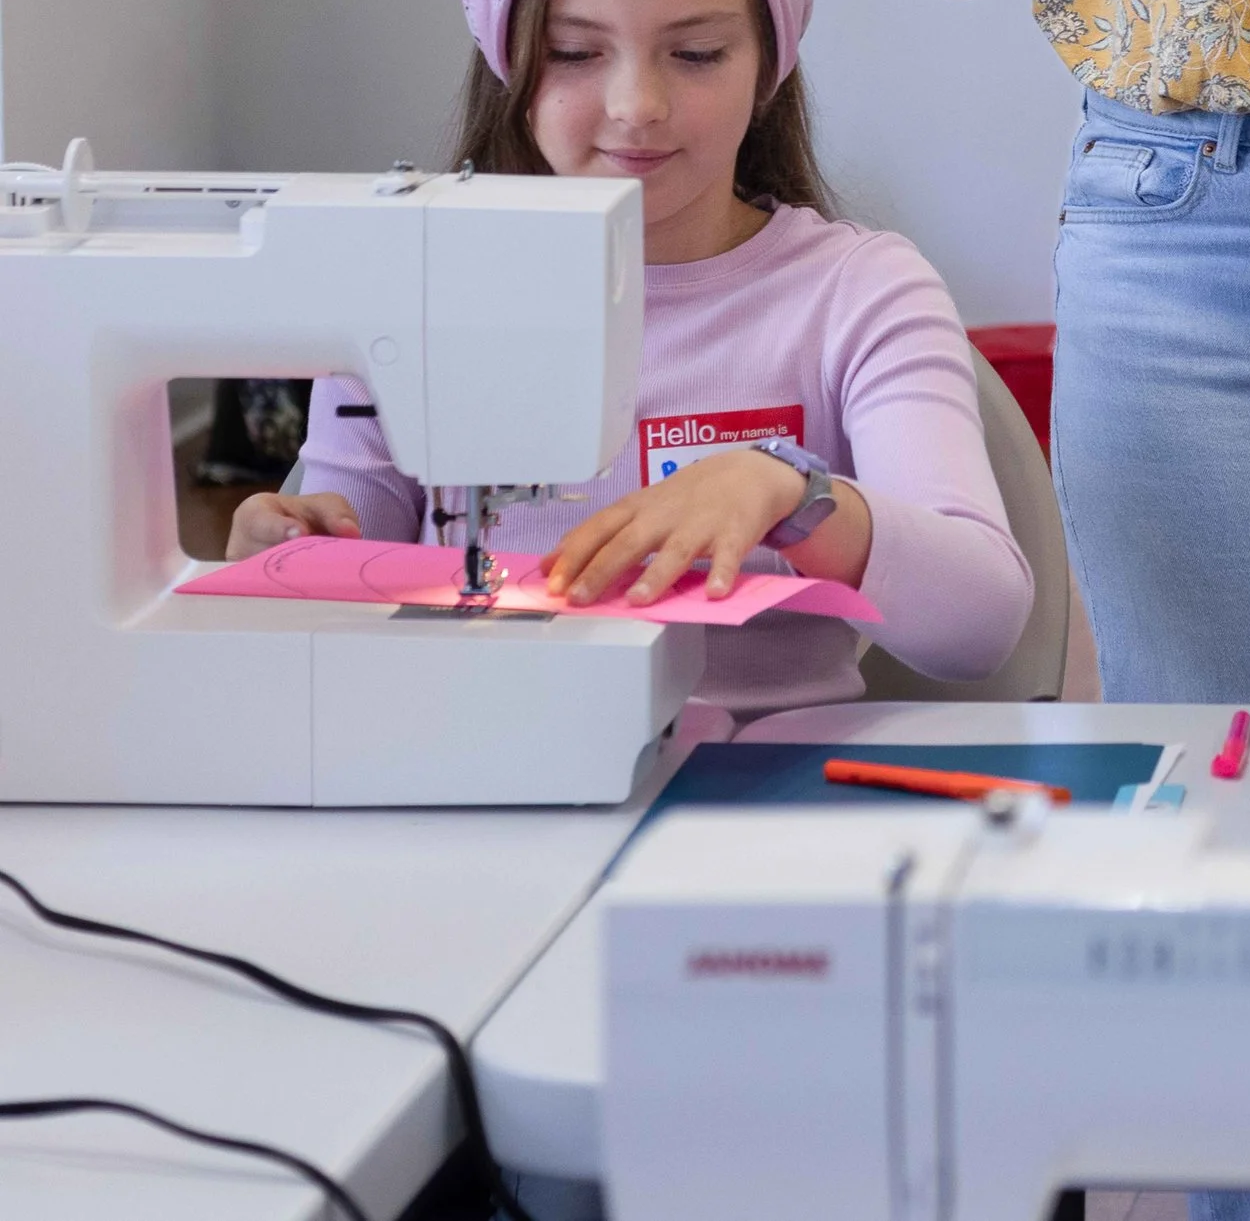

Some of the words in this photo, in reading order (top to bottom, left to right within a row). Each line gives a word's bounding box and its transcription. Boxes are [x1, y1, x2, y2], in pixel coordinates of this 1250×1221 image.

[647, 419, 716, 447] Hello
[720, 432, 739, 442] my
[742, 427, 776, 439] name
[778, 424, 788, 435] is
